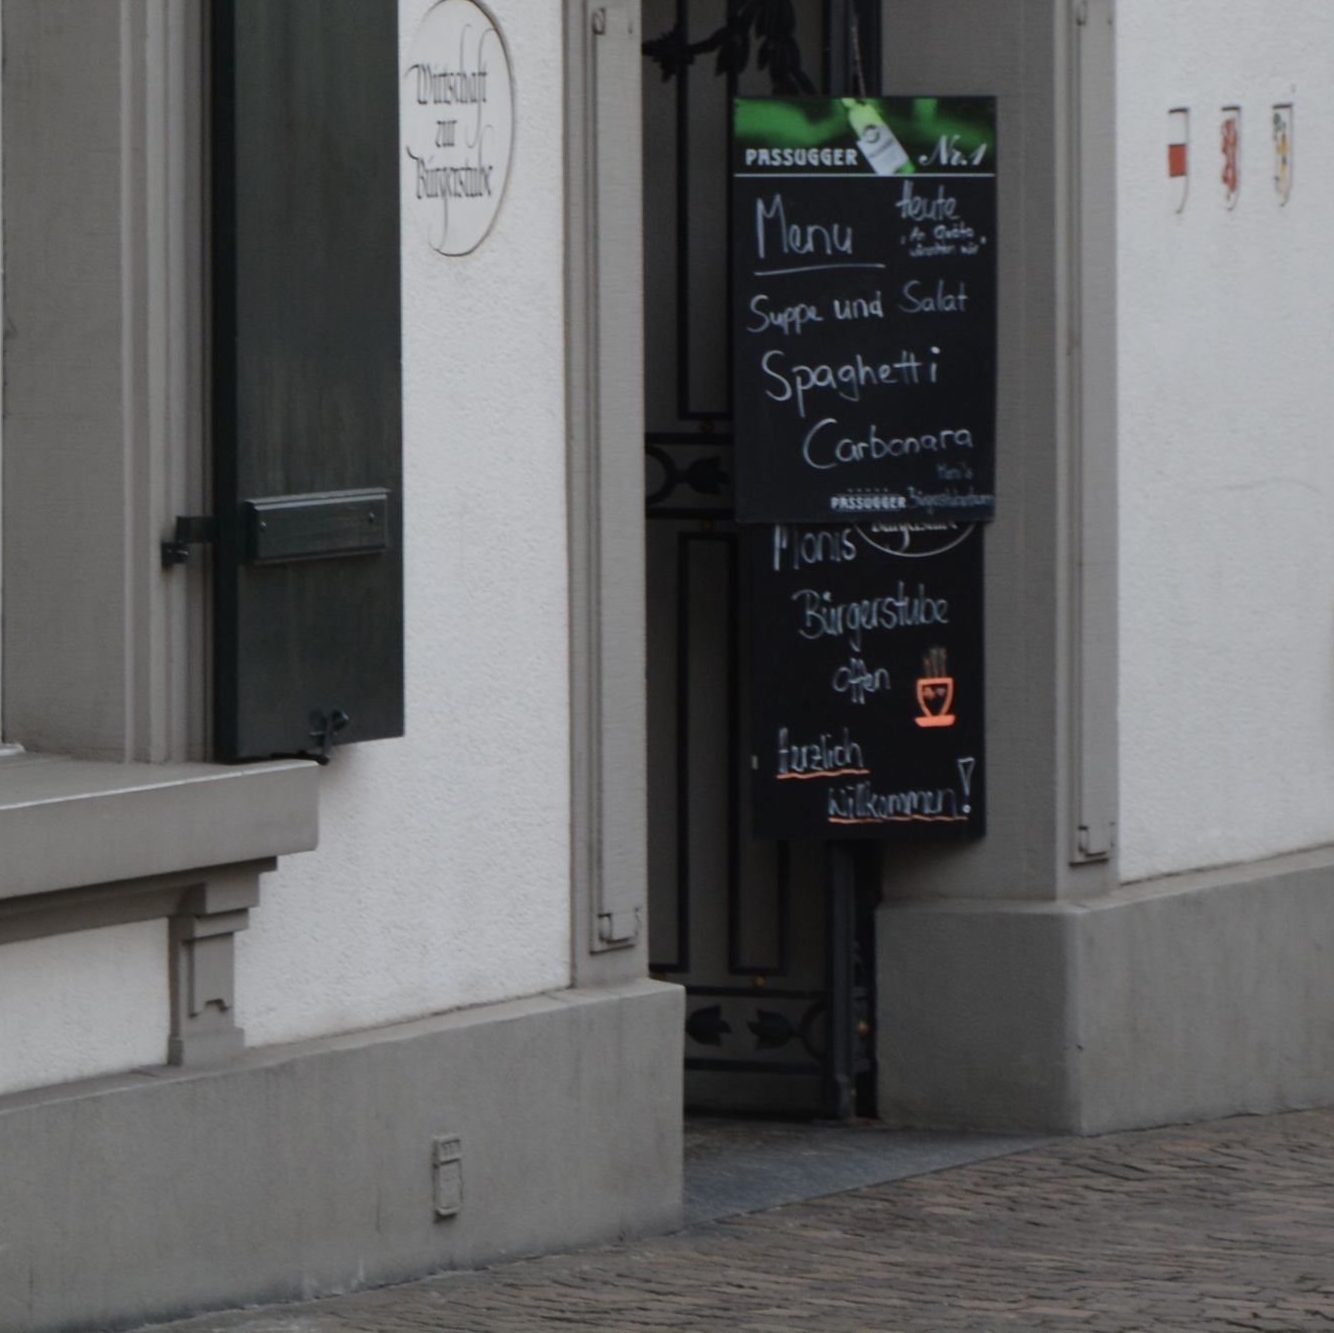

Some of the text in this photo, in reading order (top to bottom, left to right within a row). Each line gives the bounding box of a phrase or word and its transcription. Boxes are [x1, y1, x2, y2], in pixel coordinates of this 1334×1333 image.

[745, 148, 858, 166] PASSUGGER
[756, 193, 854, 258] Menu
[747, 280, 968, 335] Suppe und Salat
[762, 347, 941, 417] Spaghetti
[803, 418, 974, 469] Carbonara
[830, 496, 907, 510] PASSUGGER
[791, 580, 950, 652] Bürgerstube
